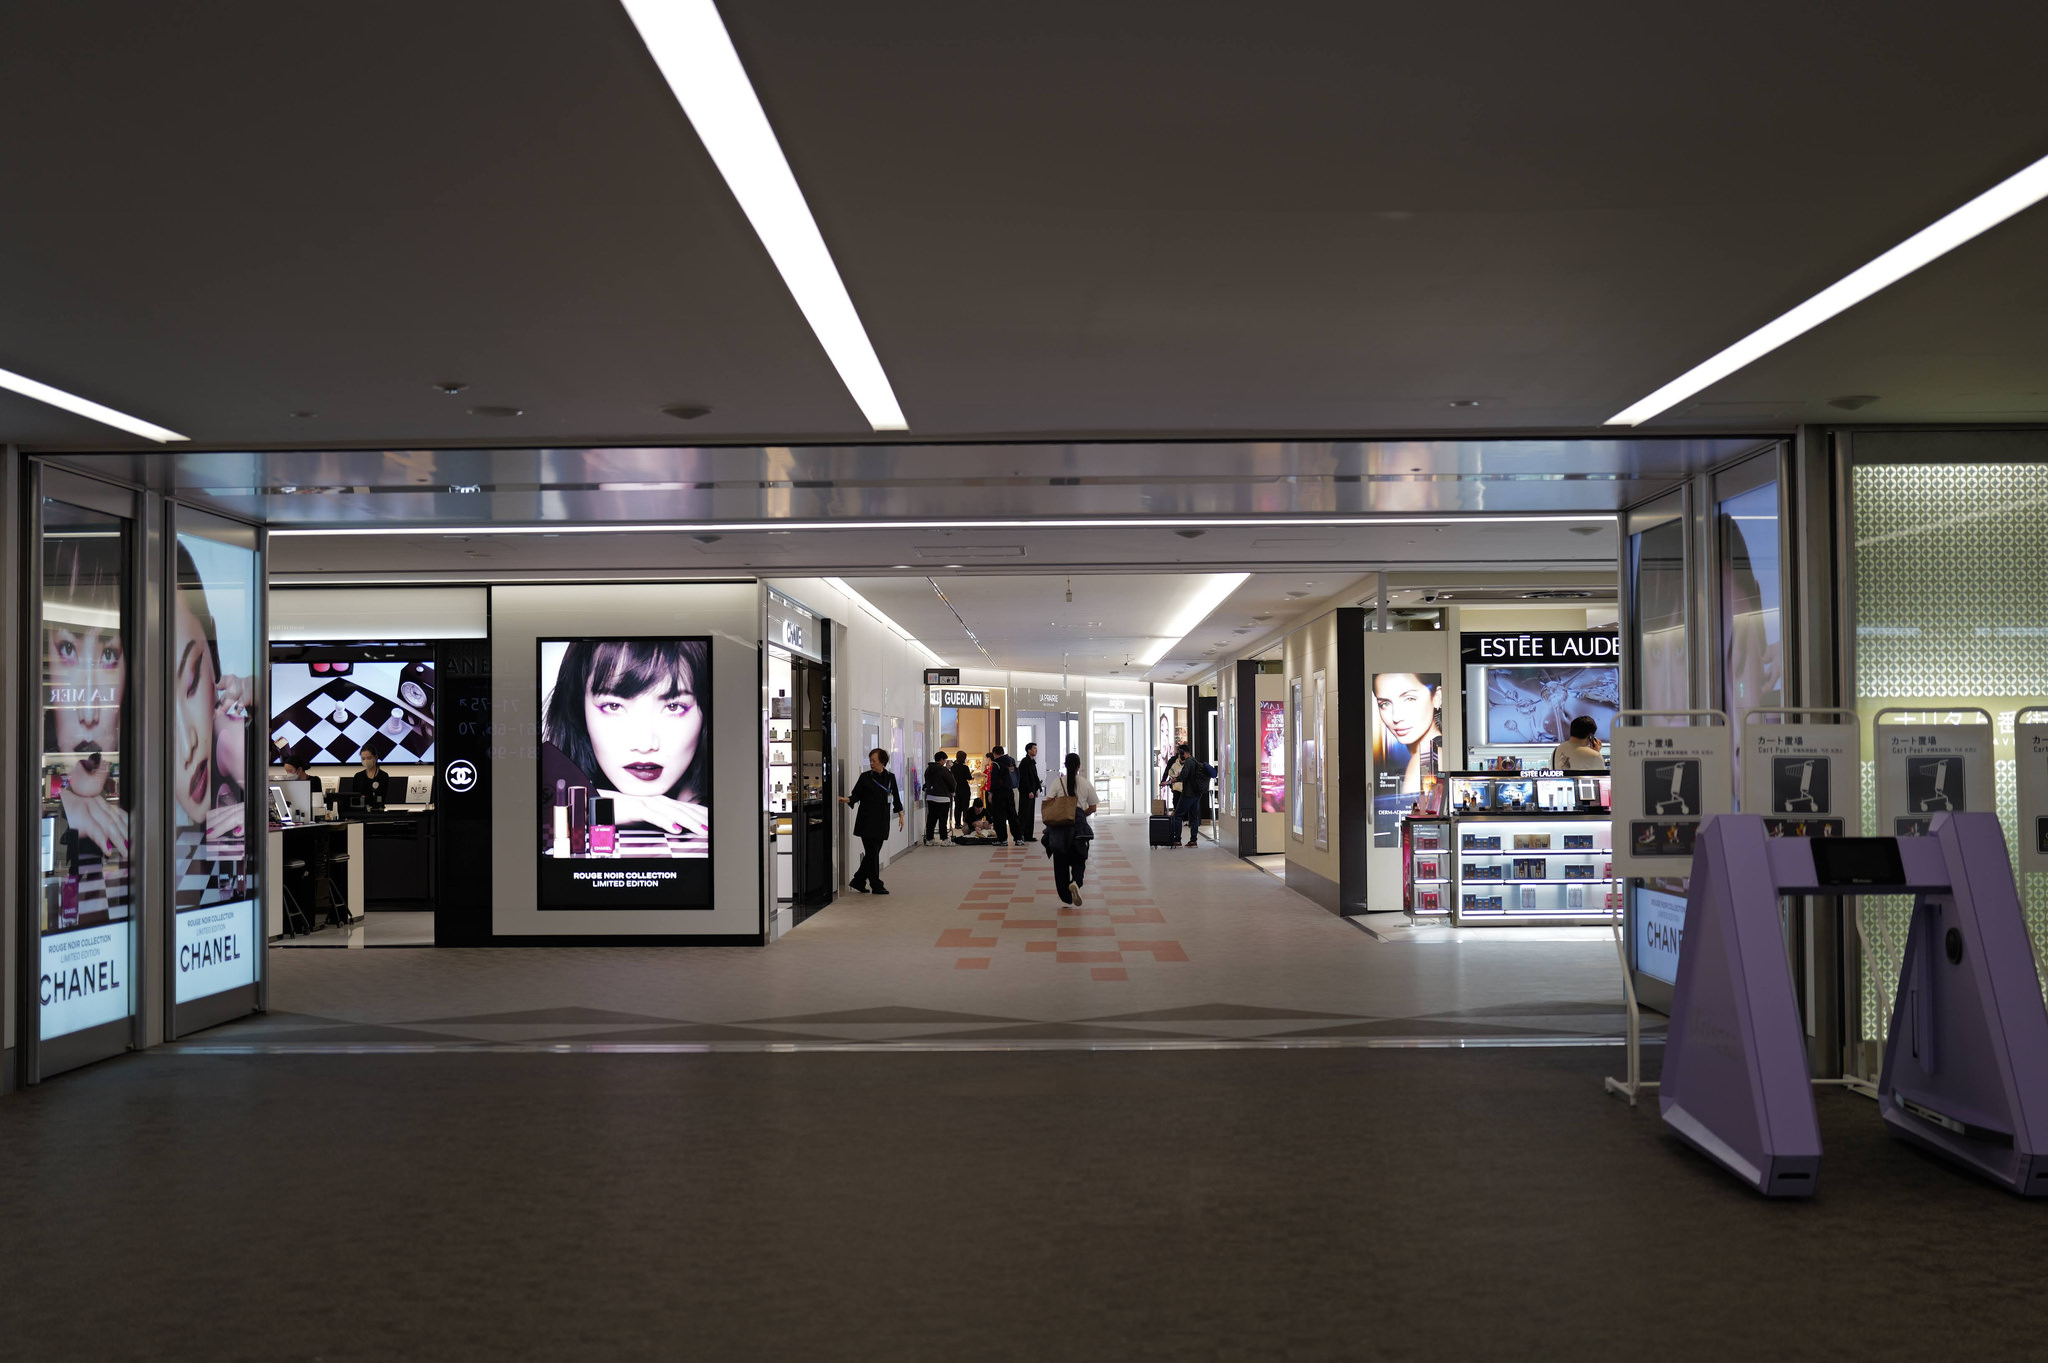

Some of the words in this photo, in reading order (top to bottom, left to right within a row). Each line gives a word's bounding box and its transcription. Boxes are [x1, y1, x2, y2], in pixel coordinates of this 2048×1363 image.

[944, 692, 982, 706] GUERLAIN
[1628, 738, 1674, 748] カート置場
[1758, 736, 1803, 746] カート置場
[1891, 736, 1937, 746] カート置場
[573, 872, 602, 880] ROUGE
[603, 872, 624, 880] NOIR
[625, 871, 677, 880] COLLECTION
[592, 880, 625, 888] LIMITED
[626, 880, 659, 888] EDITION
[48, 941, 67, 954] ROUGE
[67, 939, 81, 950] NOIR
[81, 933, 112, 948] COLLECTION
[180, 933, 241, 973] CHANEL
[40, 958, 120, 1006] CHANEL
